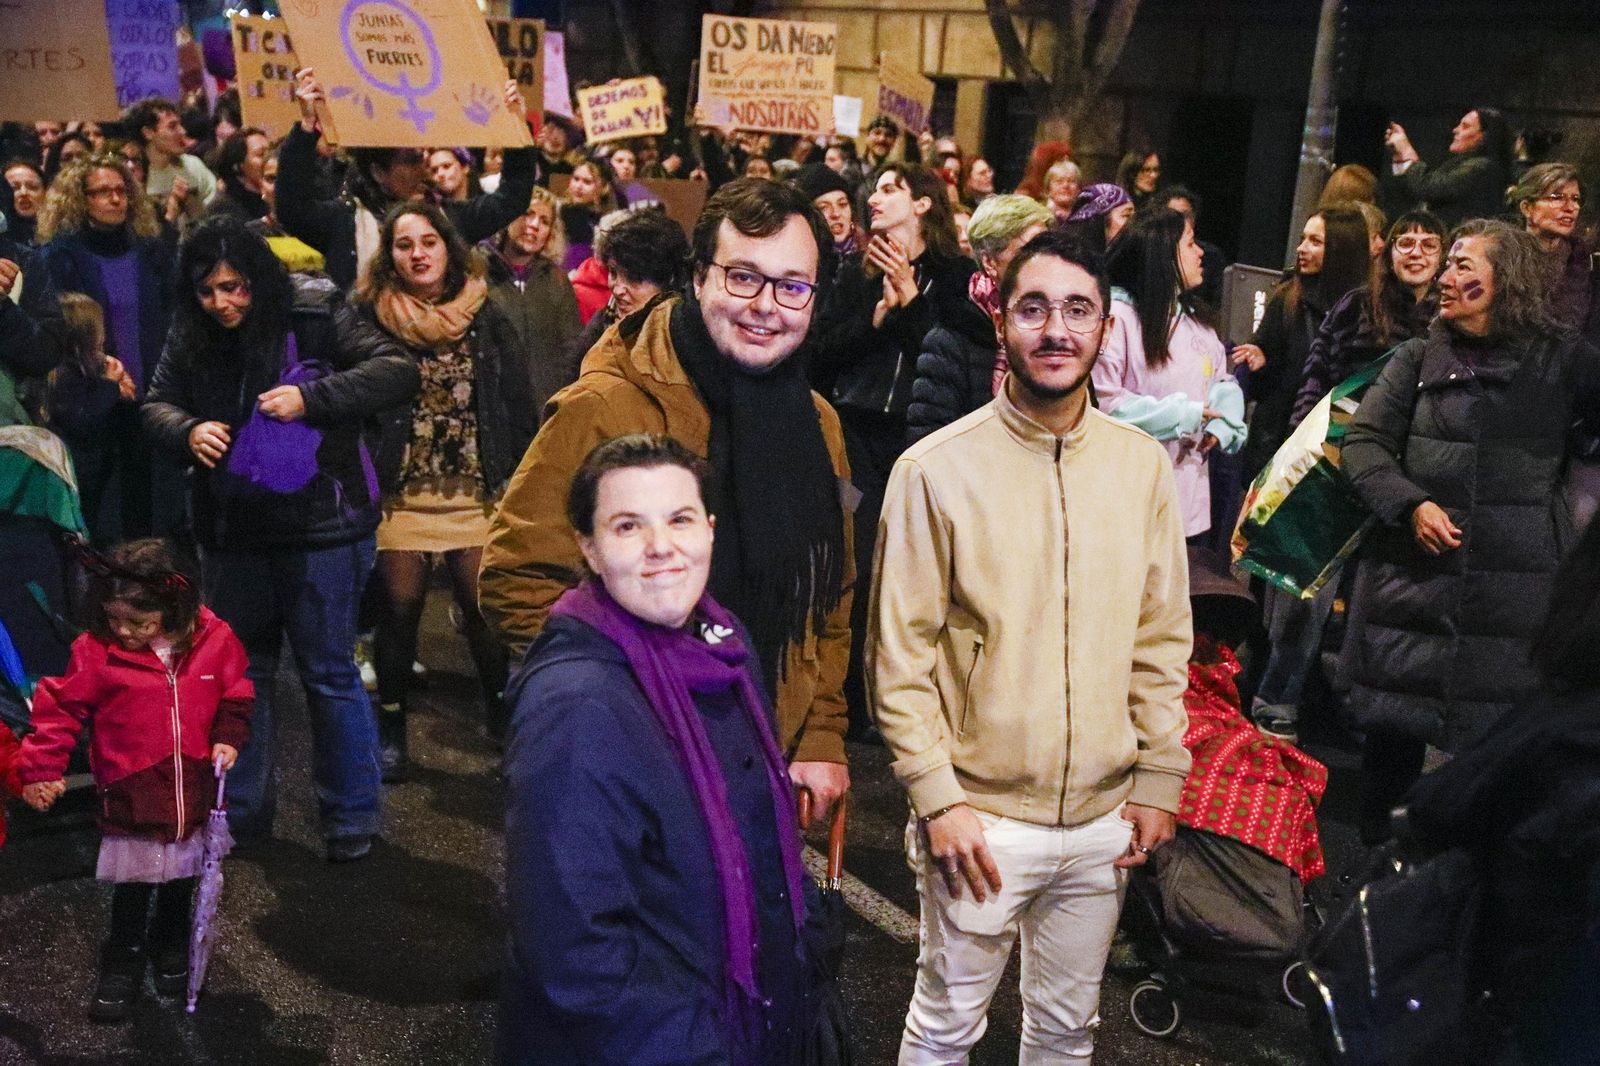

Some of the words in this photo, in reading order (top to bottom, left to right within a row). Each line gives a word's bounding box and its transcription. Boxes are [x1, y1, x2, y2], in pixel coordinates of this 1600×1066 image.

[711, 20, 747, 51] OS
[757, 23, 783, 54] DA
[366, 48, 423, 66] FUERTES
[707, 51, 728, 75] EL
[588, 83, 648, 108] DEJEMOS
[727, 99, 819, 131] NOSOTRAS
